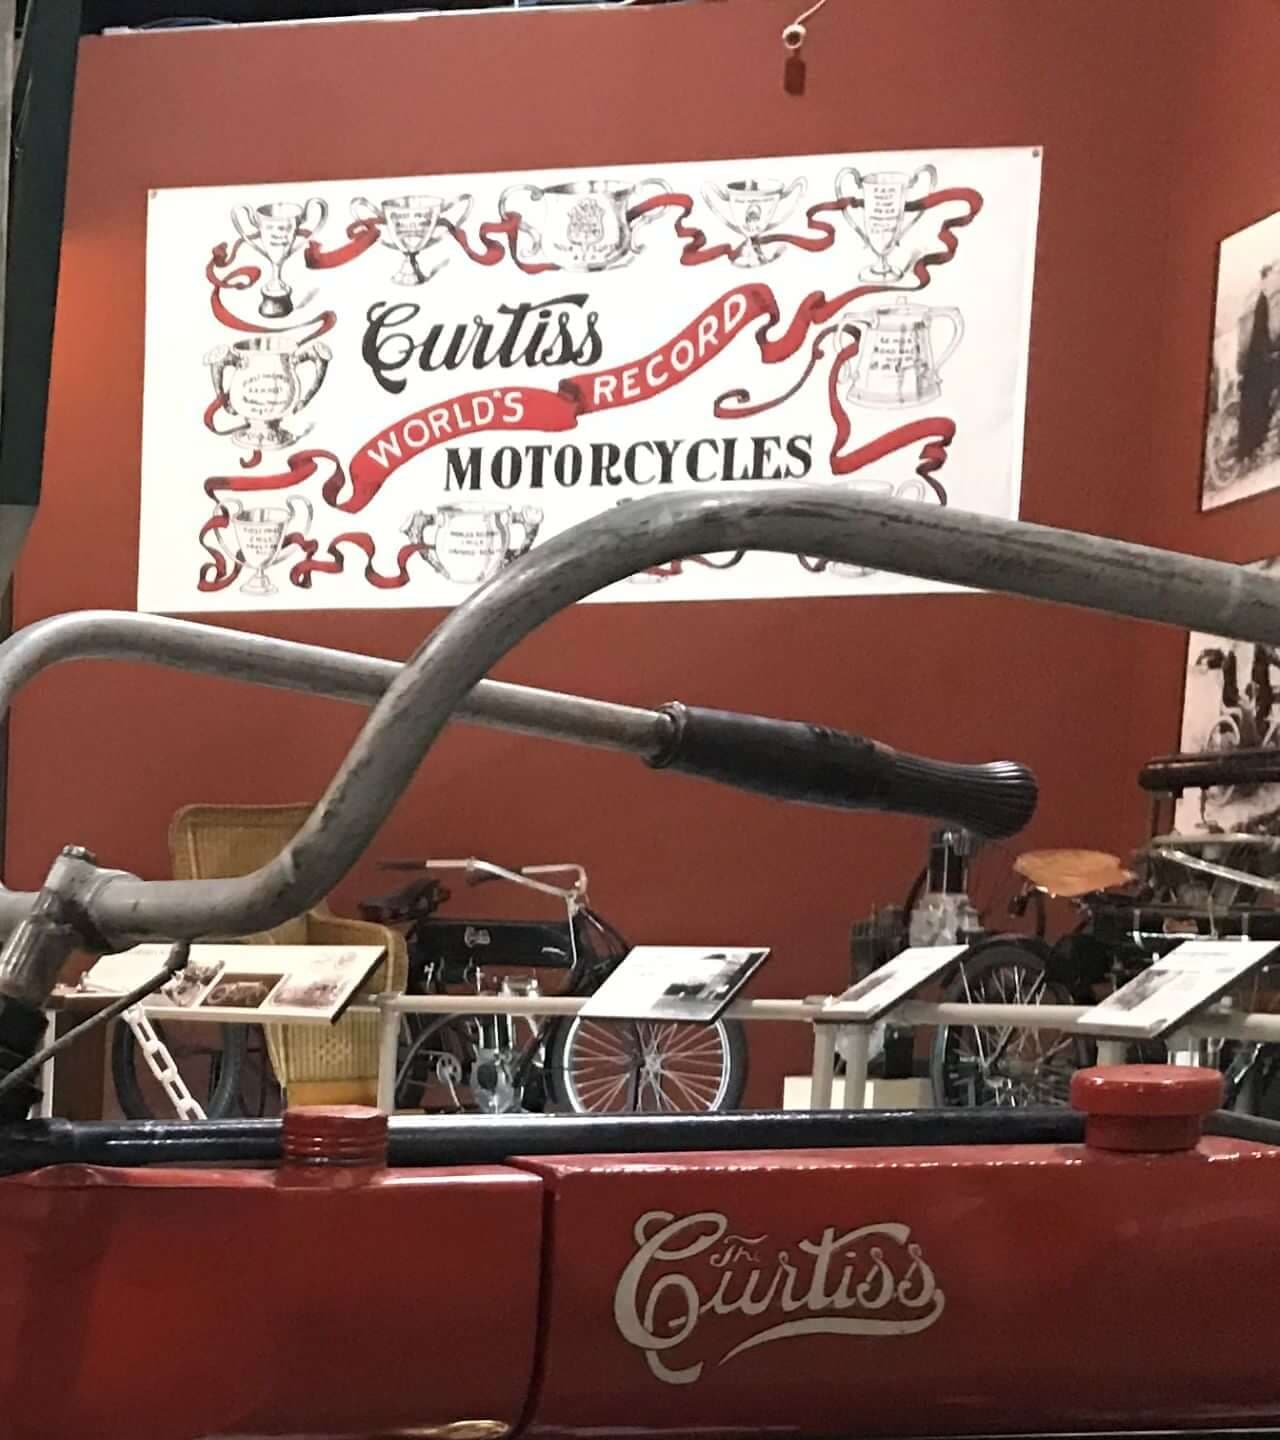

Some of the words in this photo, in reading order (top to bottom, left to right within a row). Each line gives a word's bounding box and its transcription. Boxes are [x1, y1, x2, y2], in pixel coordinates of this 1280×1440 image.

[362, 293, 604, 394] Curtiss
[367, 389, 525, 469] WORLD'S
[592, 293, 747, 405] RECORD
[444, 434, 813, 492] MOTORCYCLES
[614, 1210, 945, 1385] Curtiss
